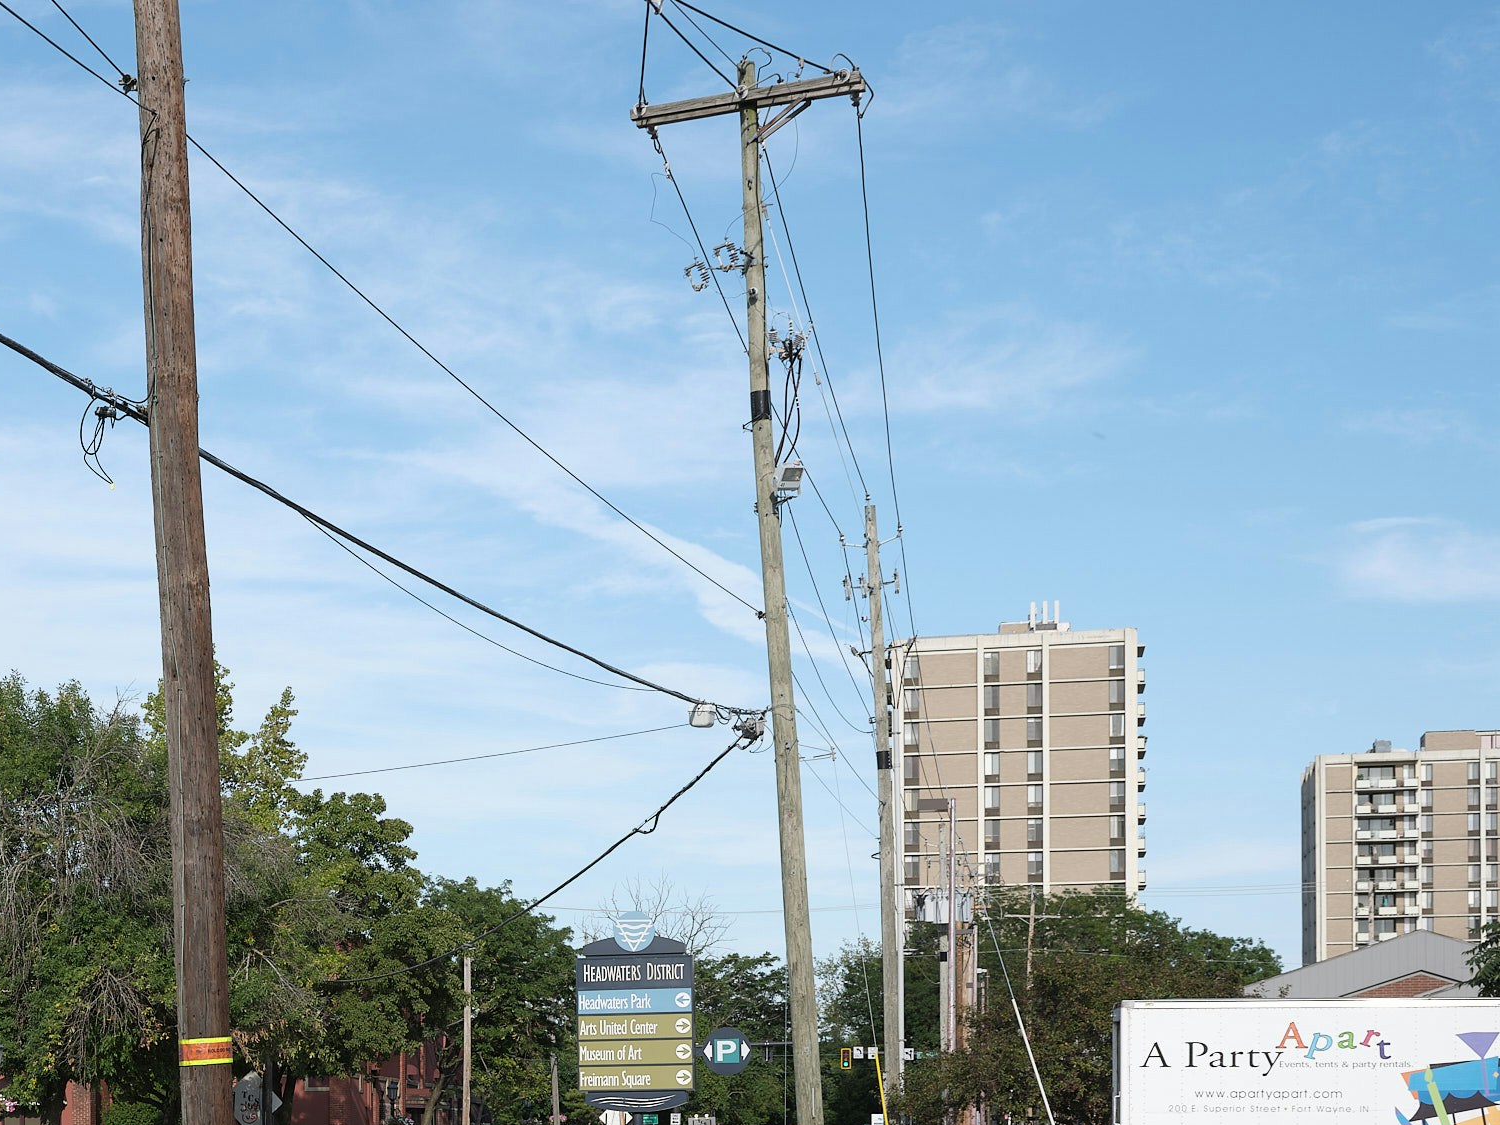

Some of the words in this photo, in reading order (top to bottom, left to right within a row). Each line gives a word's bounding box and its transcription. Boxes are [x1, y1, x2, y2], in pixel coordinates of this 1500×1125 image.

[583, 963, 642, 983] HEADWATERS
[646, 962, 685, 981] DISTRICT
[578, 995, 629, 1011] Headwaters
[630, 993, 651, 1010] Park
[580, 1020, 597, 1036] Arts
[599, 1019, 628, 1035] United
[629, 1019, 658, 1035] Center
[579, 1046, 617, 1062] Museum
[617, 1044, 627, 1061] of
[628, 1045, 643, 1060] Art
[716, 1041, 737, 1062] P
[1139, 1041, 1172, 1068] A
[1184, 1041, 1284, 1077] Party
[1275, 1021, 1392, 1060] Apart
[1279, 1060, 1312, 1069] Events,
[1341, 1060, 1349, 1068] &
[1352, 1061, 1377, 1070] party
[1379, 1060, 1414, 1068] rentals.
[579, 1071, 619, 1087] Freimann
[621, 1070, 651, 1088] Square
[1194, 1089, 1343, 1101] www.apartyapart.com
[1168, 1105, 1188, 1113] 200
[1203, 1104, 1246, 1114] Superior
[1250, 1104, 1281, 1113] Street
[1291, 1105, 1311, 1113] Fort
[1316, 1105, 1356, 1114] Wayne,
[1359, 1105, 1370, 1113] IN
